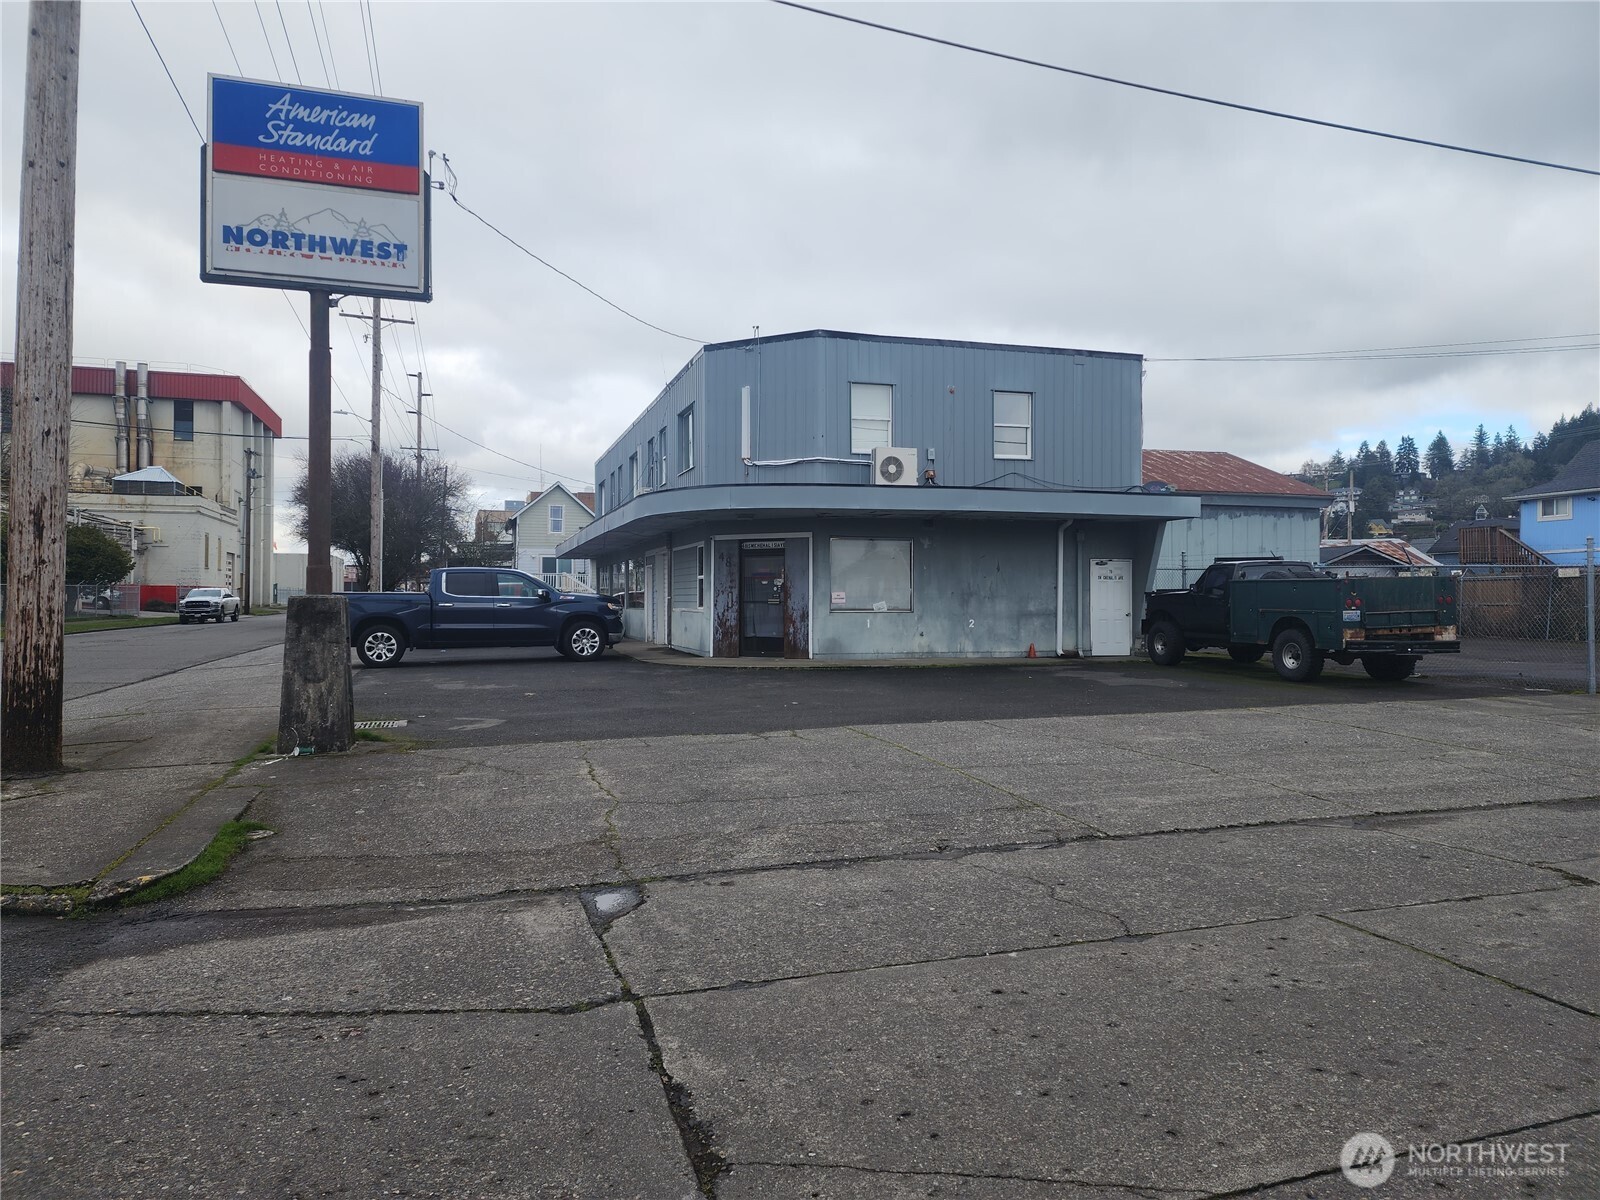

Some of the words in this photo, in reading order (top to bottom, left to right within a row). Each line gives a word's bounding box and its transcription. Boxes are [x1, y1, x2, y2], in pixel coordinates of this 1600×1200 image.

[265, 92, 376, 131] American
[258, 120, 379, 155] Standard
[259, 153, 323, 168] HEATING
[333, 162, 341, 170] &
[350, 164, 374, 174] AIR
[259, 163, 373, 184] CONDITIONING
[222, 224, 408, 262] NORTHWEST
[968, 618, 975, 628] 2
